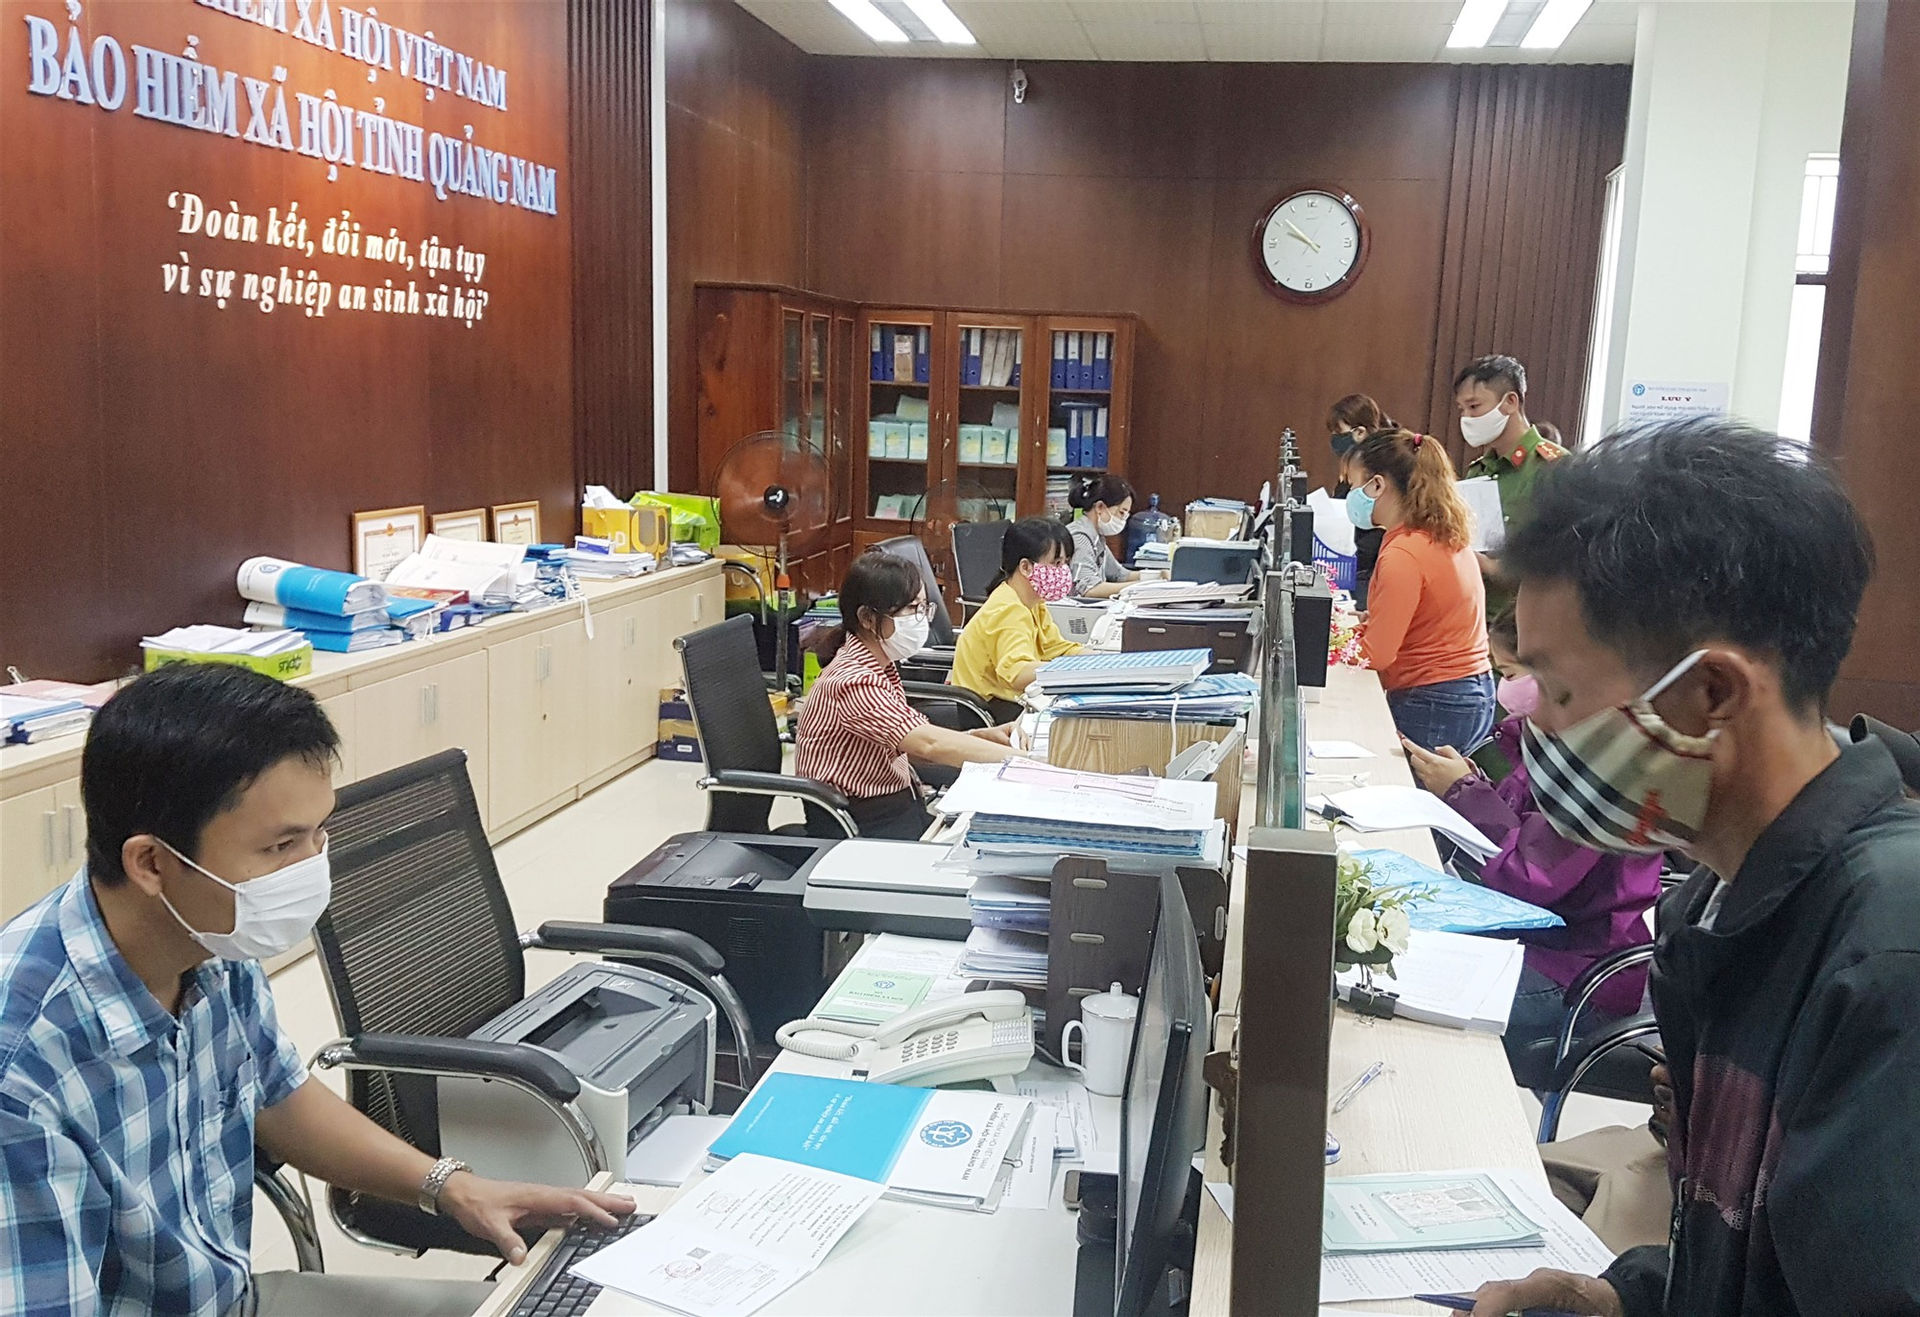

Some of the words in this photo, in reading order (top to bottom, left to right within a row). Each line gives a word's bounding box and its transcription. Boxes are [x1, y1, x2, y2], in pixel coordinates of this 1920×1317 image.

[338, 7, 393, 83] HỘI
[394, 30, 454, 101] VIỆT
[455, 53, 508, 111] NAM
[24, 0, 127, 110] BẢO
[131, 34, 240, 138] HIỂM
[242, 65, 294, 150] XÃ
[295, 88, 356, 182] HỘI
[356, 96, 425, 182] TỈNH
[429, 124, 508, 201] QUẢNG
[509, 155, 557, 215] NAM
[161, 251, 191, 294] vì
[199, 268, 236, 310] sự
[242, 266, 332, 318] nghiệp
[338, 284, 367, 311] an
[372, 279, 420, 315] sinh
[424, 283, 449, 318] xã
[322, 210, 361, 257] đổi
[419, 235, 451, 278] tận
[456, 245, 486, 283] tụy
